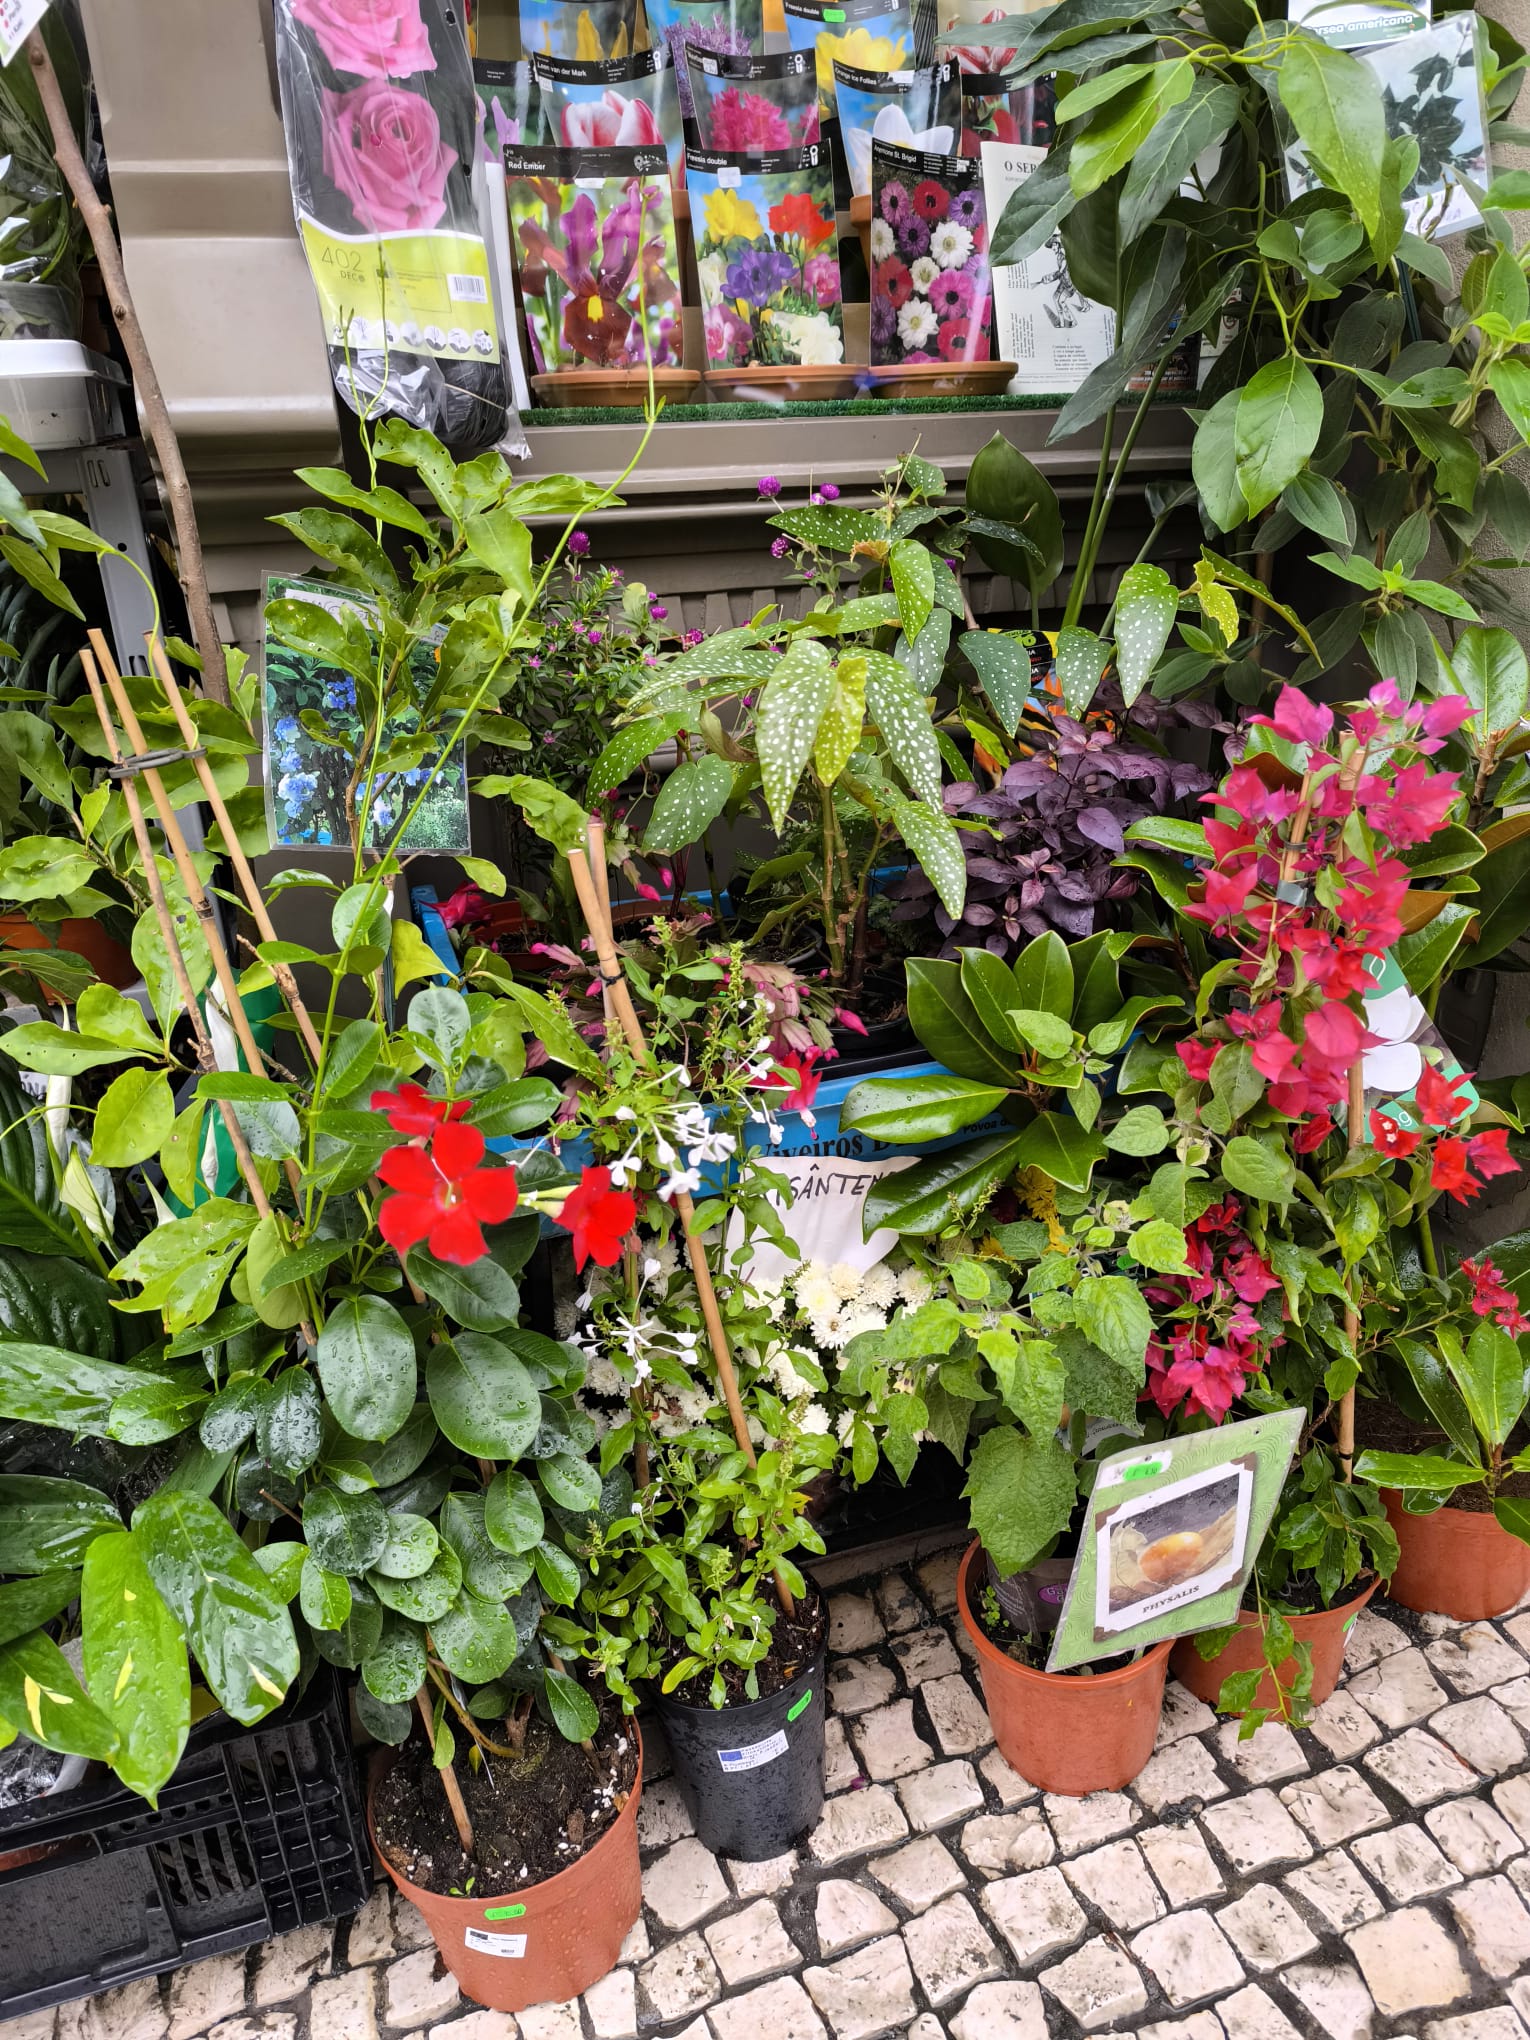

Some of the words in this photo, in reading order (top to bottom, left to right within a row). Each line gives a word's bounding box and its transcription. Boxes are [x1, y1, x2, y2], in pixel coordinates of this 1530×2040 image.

[1347, 14, 1413, 32] americana
[550, 66, 561, 74] van
[560, 67, 571, 76] der
[571, 68, 587, 77] Mark
[859, 76, 877, 86] Follies
[687, 152, 706, 163] Freesia
[706, 157, 728, 166] double
[873, 145, 894, 157] Anemone
[901, 152, 917, 163] Brigid
[508, 160, 522, 169] Red
[523, 161, 546, 171] Ember
[1004, 160, 1013, 172] O
[1016, 162, 1037, 174] SER
[321, 247, 364, 273] 402
[1142, 1585, 1200, 1614] PHYSALIS
